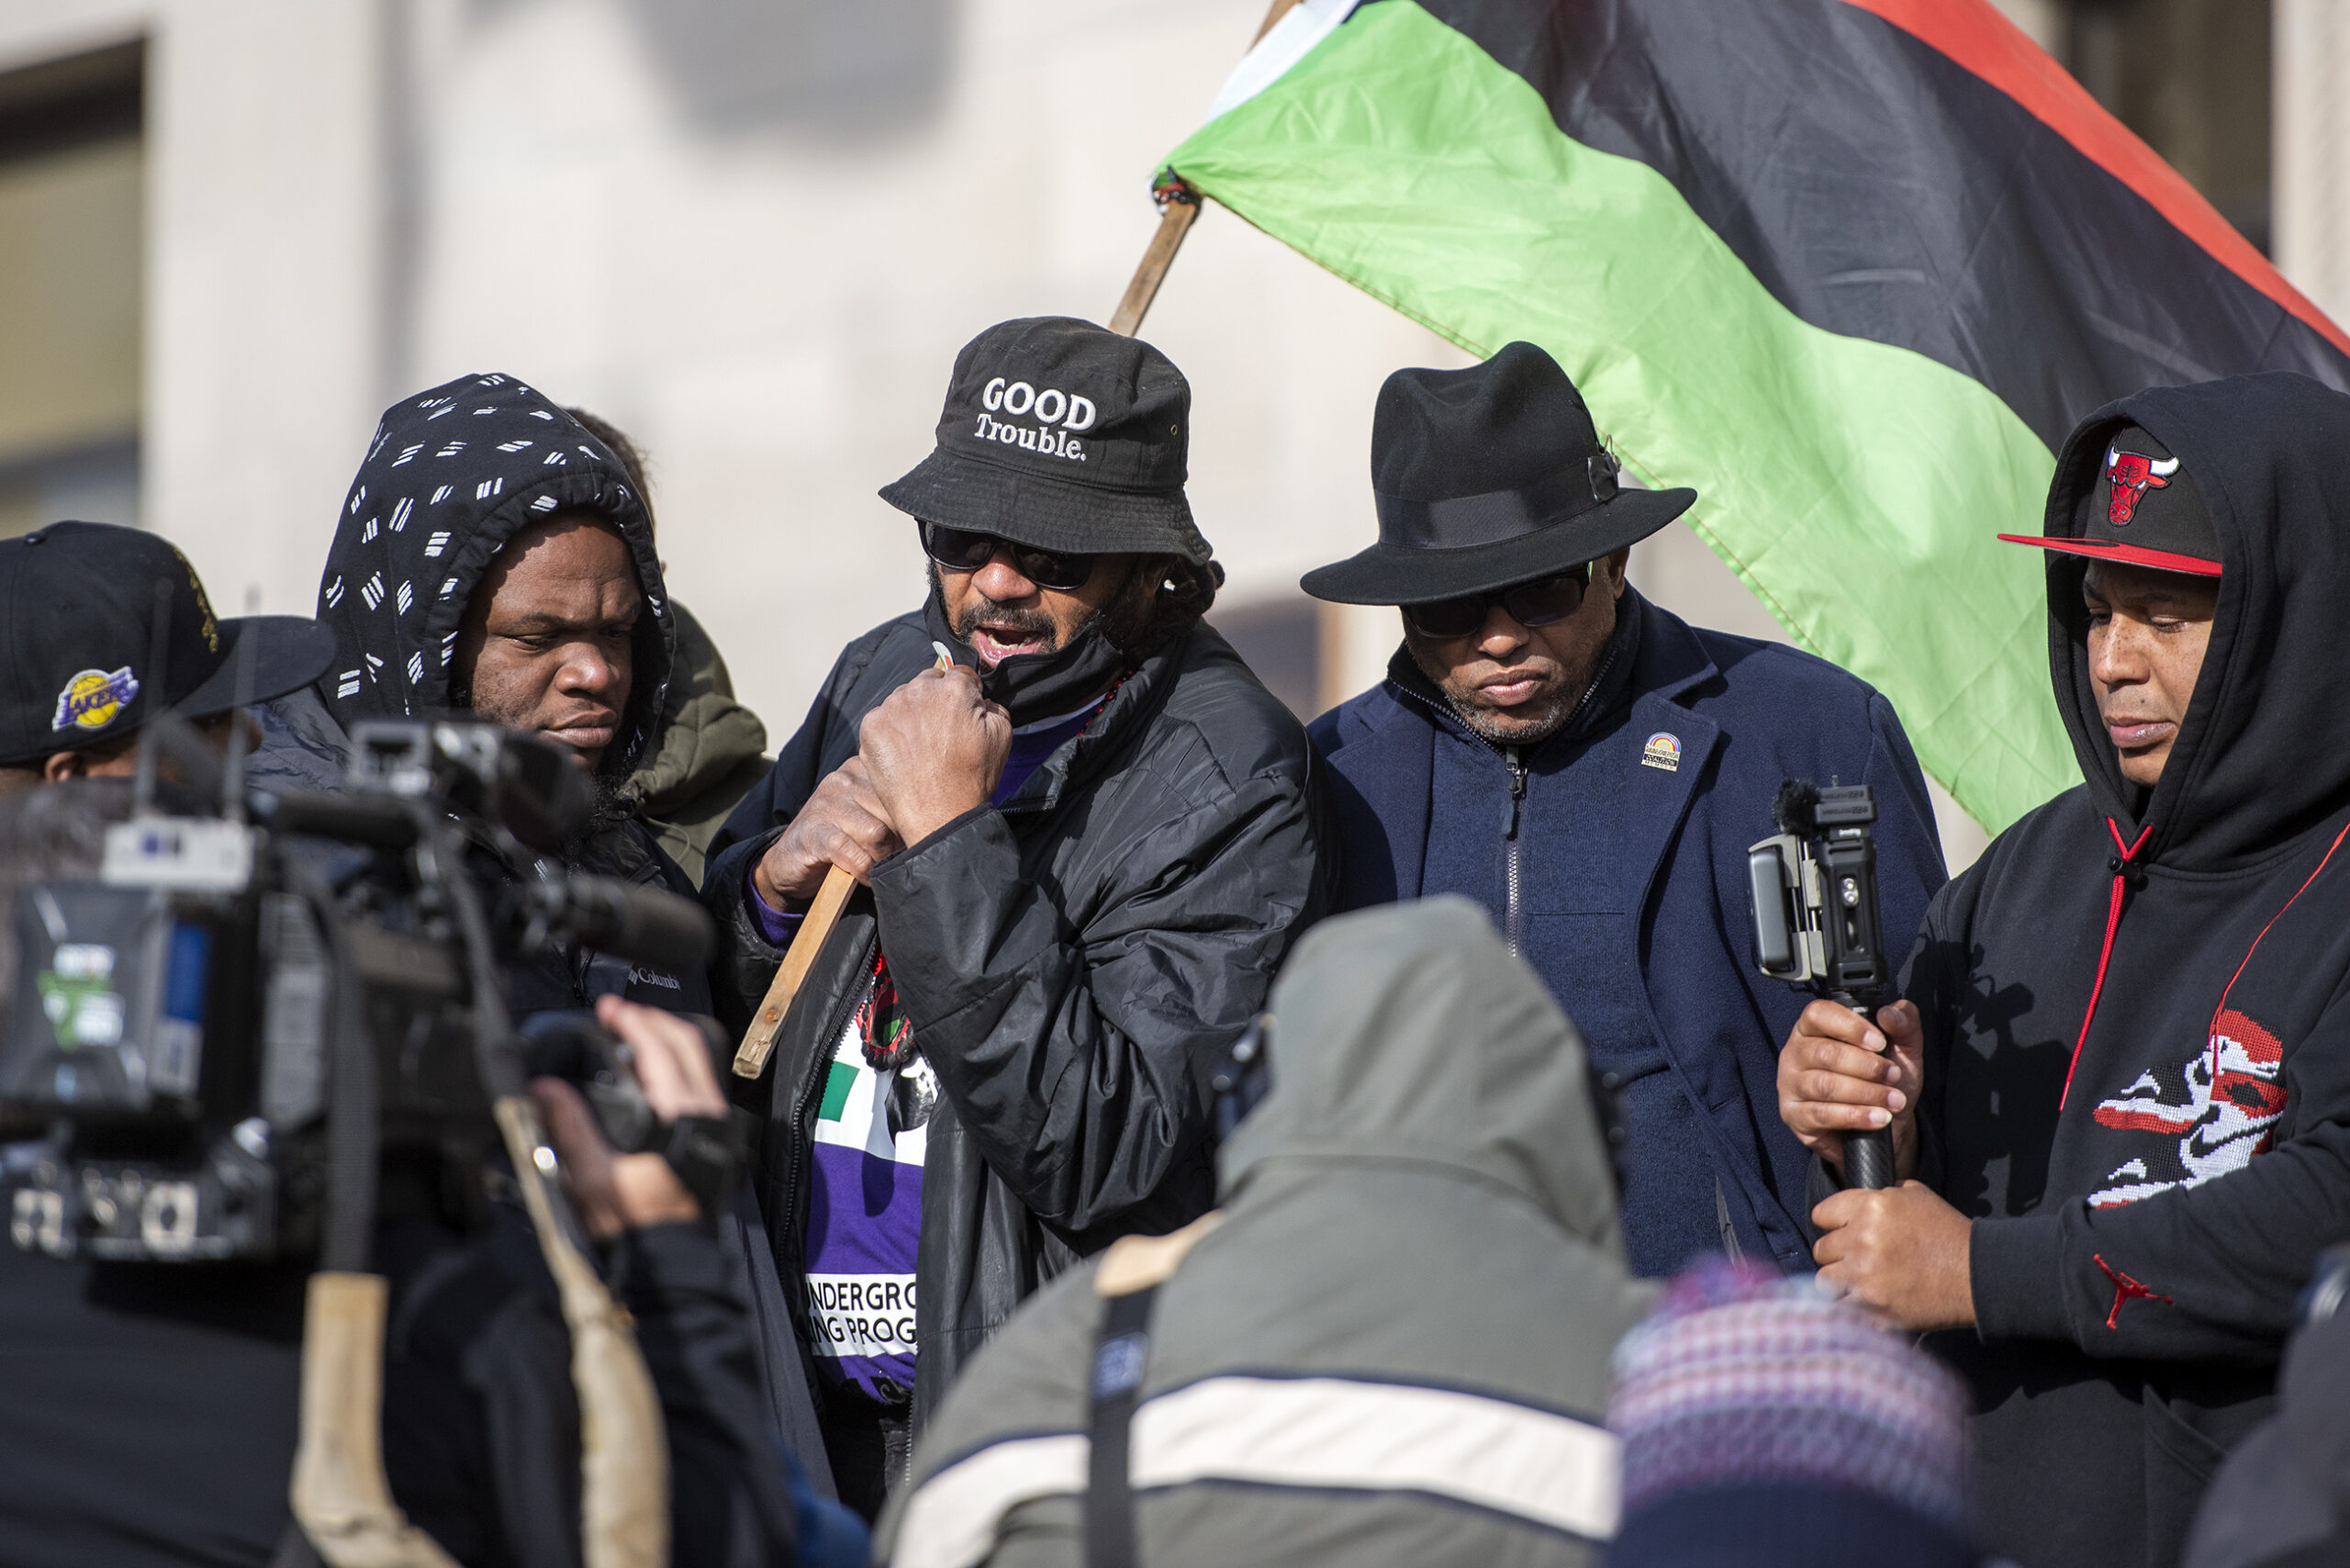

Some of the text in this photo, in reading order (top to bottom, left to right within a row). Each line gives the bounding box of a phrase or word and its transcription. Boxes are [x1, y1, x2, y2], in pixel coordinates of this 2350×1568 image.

[982, 377, 1096, 431] GOOD
[974, 413, 1087, 462] Trouble.
[637, 968, 681, 990] Columbi
[808, 1282, 916, 1311] NDERGRO
[808, 1316, 917, 1345] ING PROG
